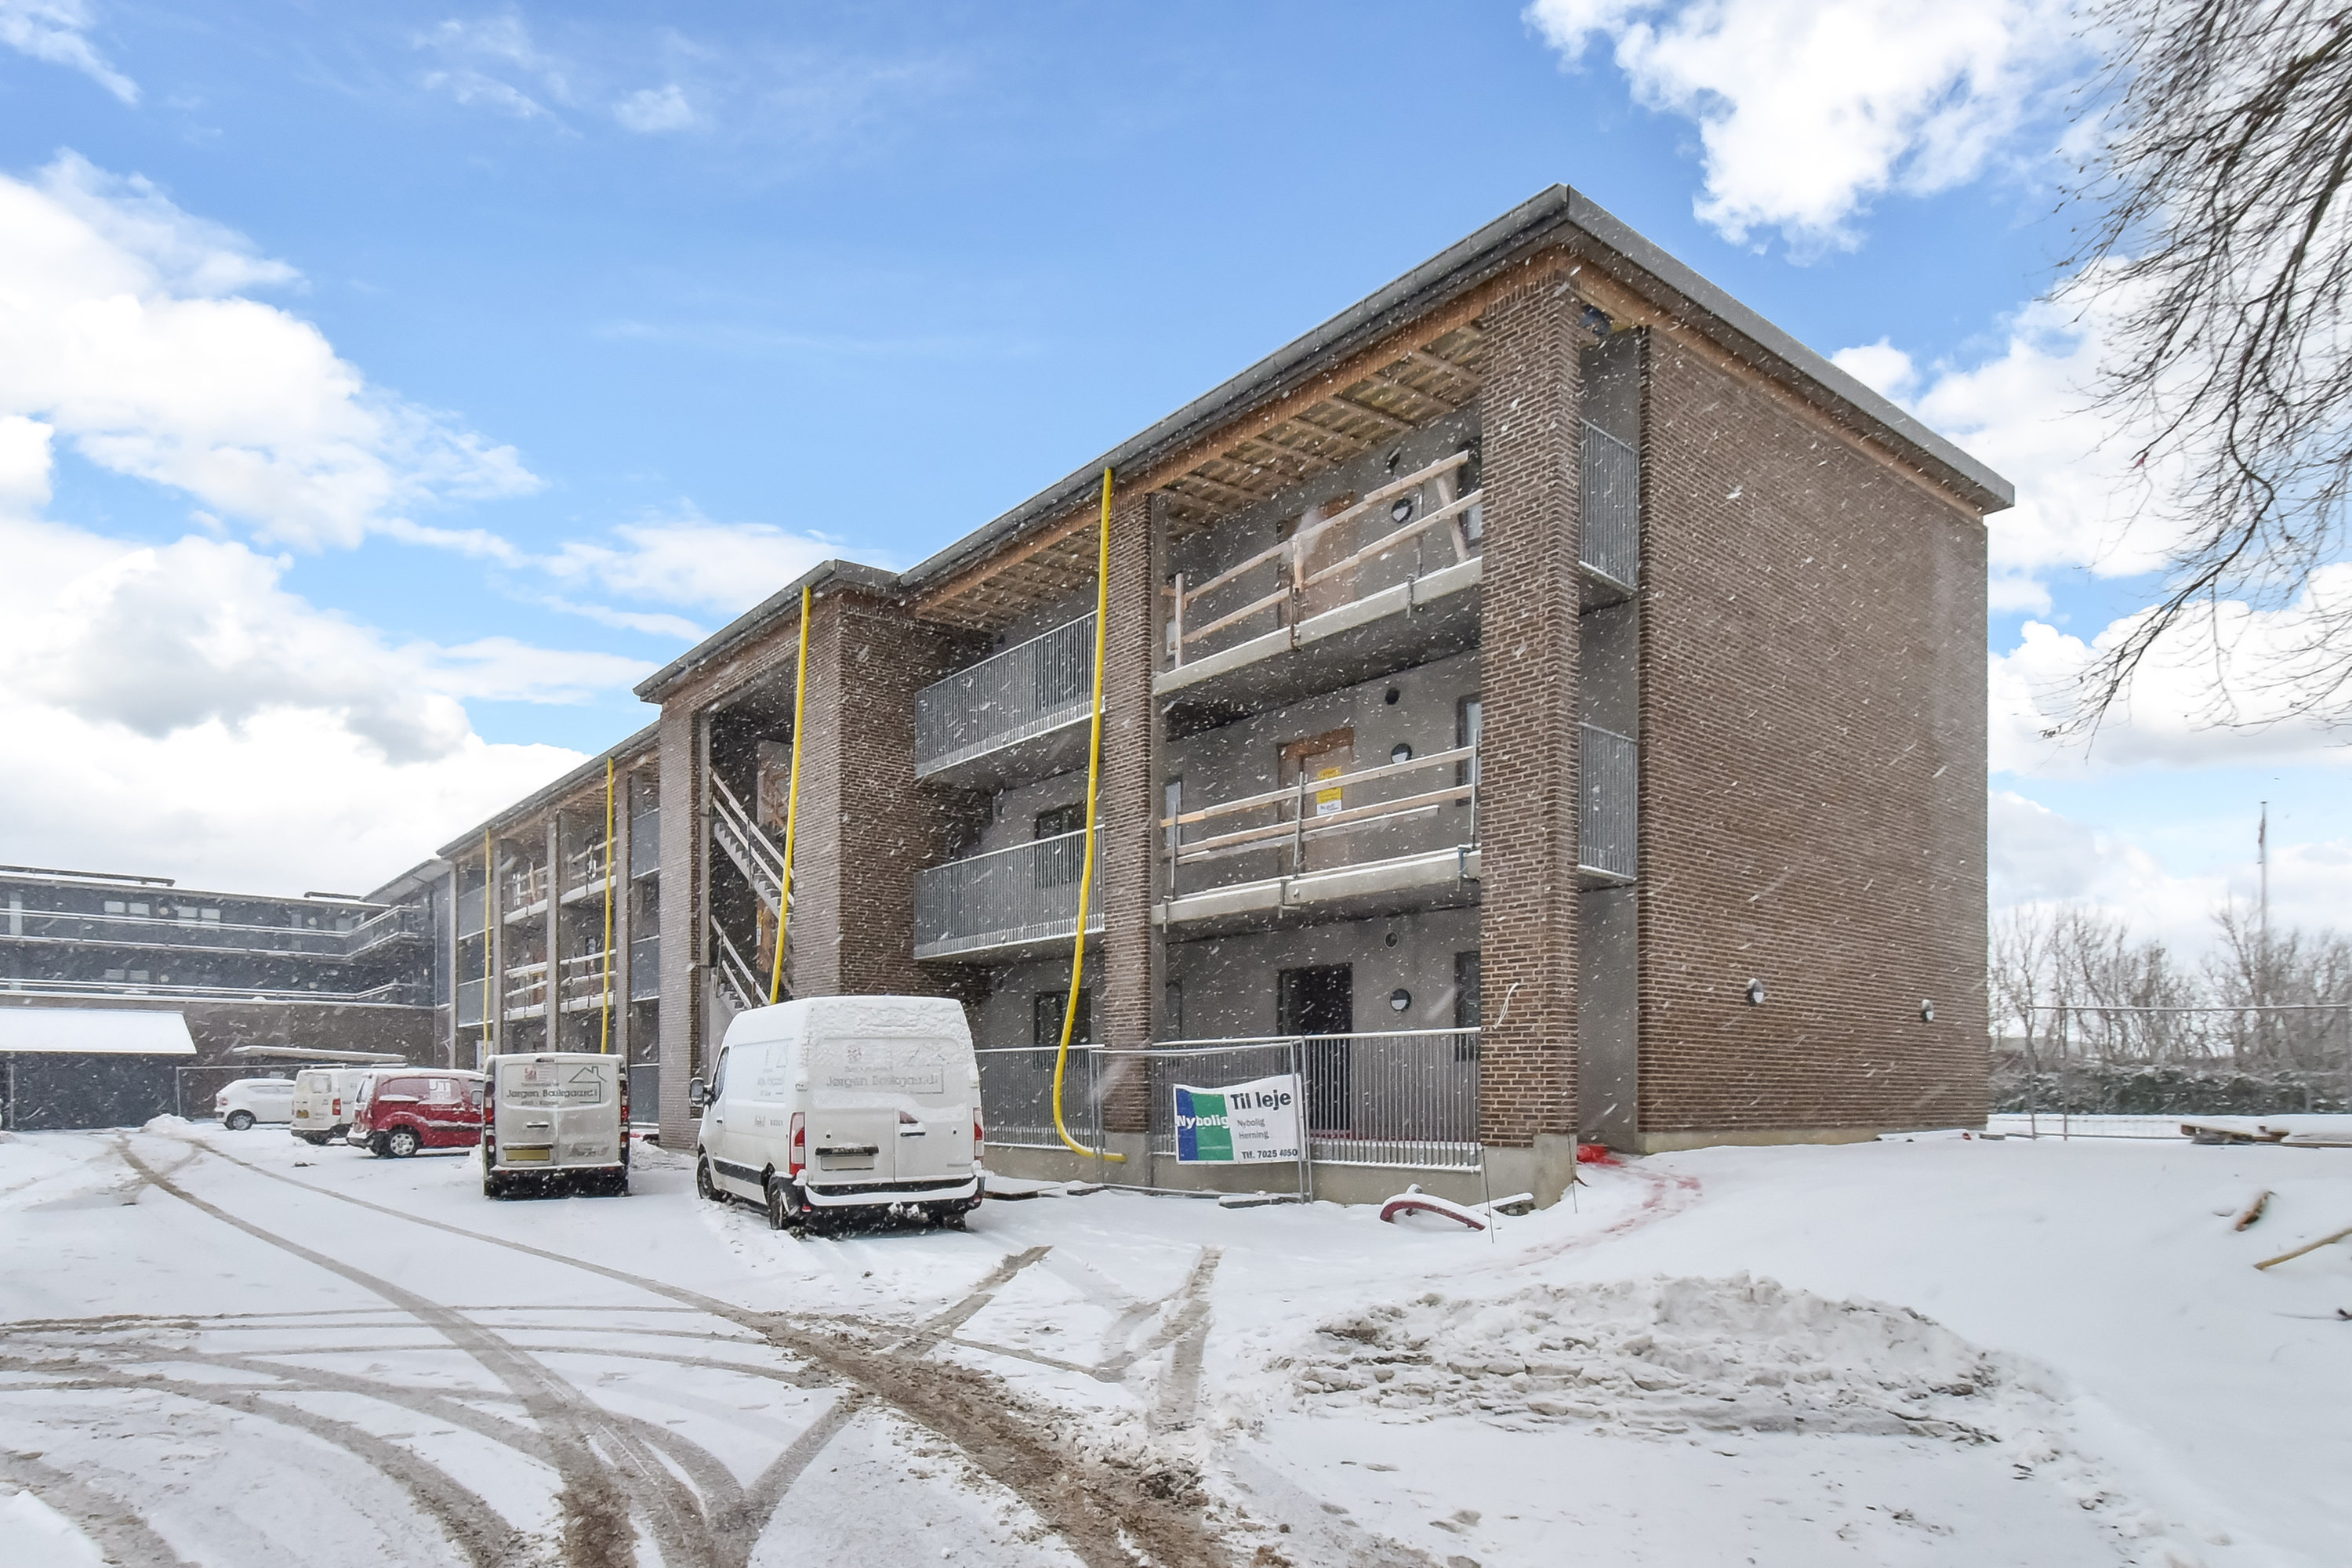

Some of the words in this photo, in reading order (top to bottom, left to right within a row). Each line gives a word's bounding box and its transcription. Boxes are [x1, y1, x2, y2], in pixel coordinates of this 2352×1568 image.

[1230, 1093, 1251, 1110] Til
[1255, 1089, 1292, 1111] leje
[1176, 1115, 1230, 1130] Nybolig
[1237, 1118, 1265, 1129] Nybolig
[1239, 1131, 1269, 1140] Herning
[1258, 1149, 1277, 1159] 7025
[1279, 1149, 1298, 1157] 4050
